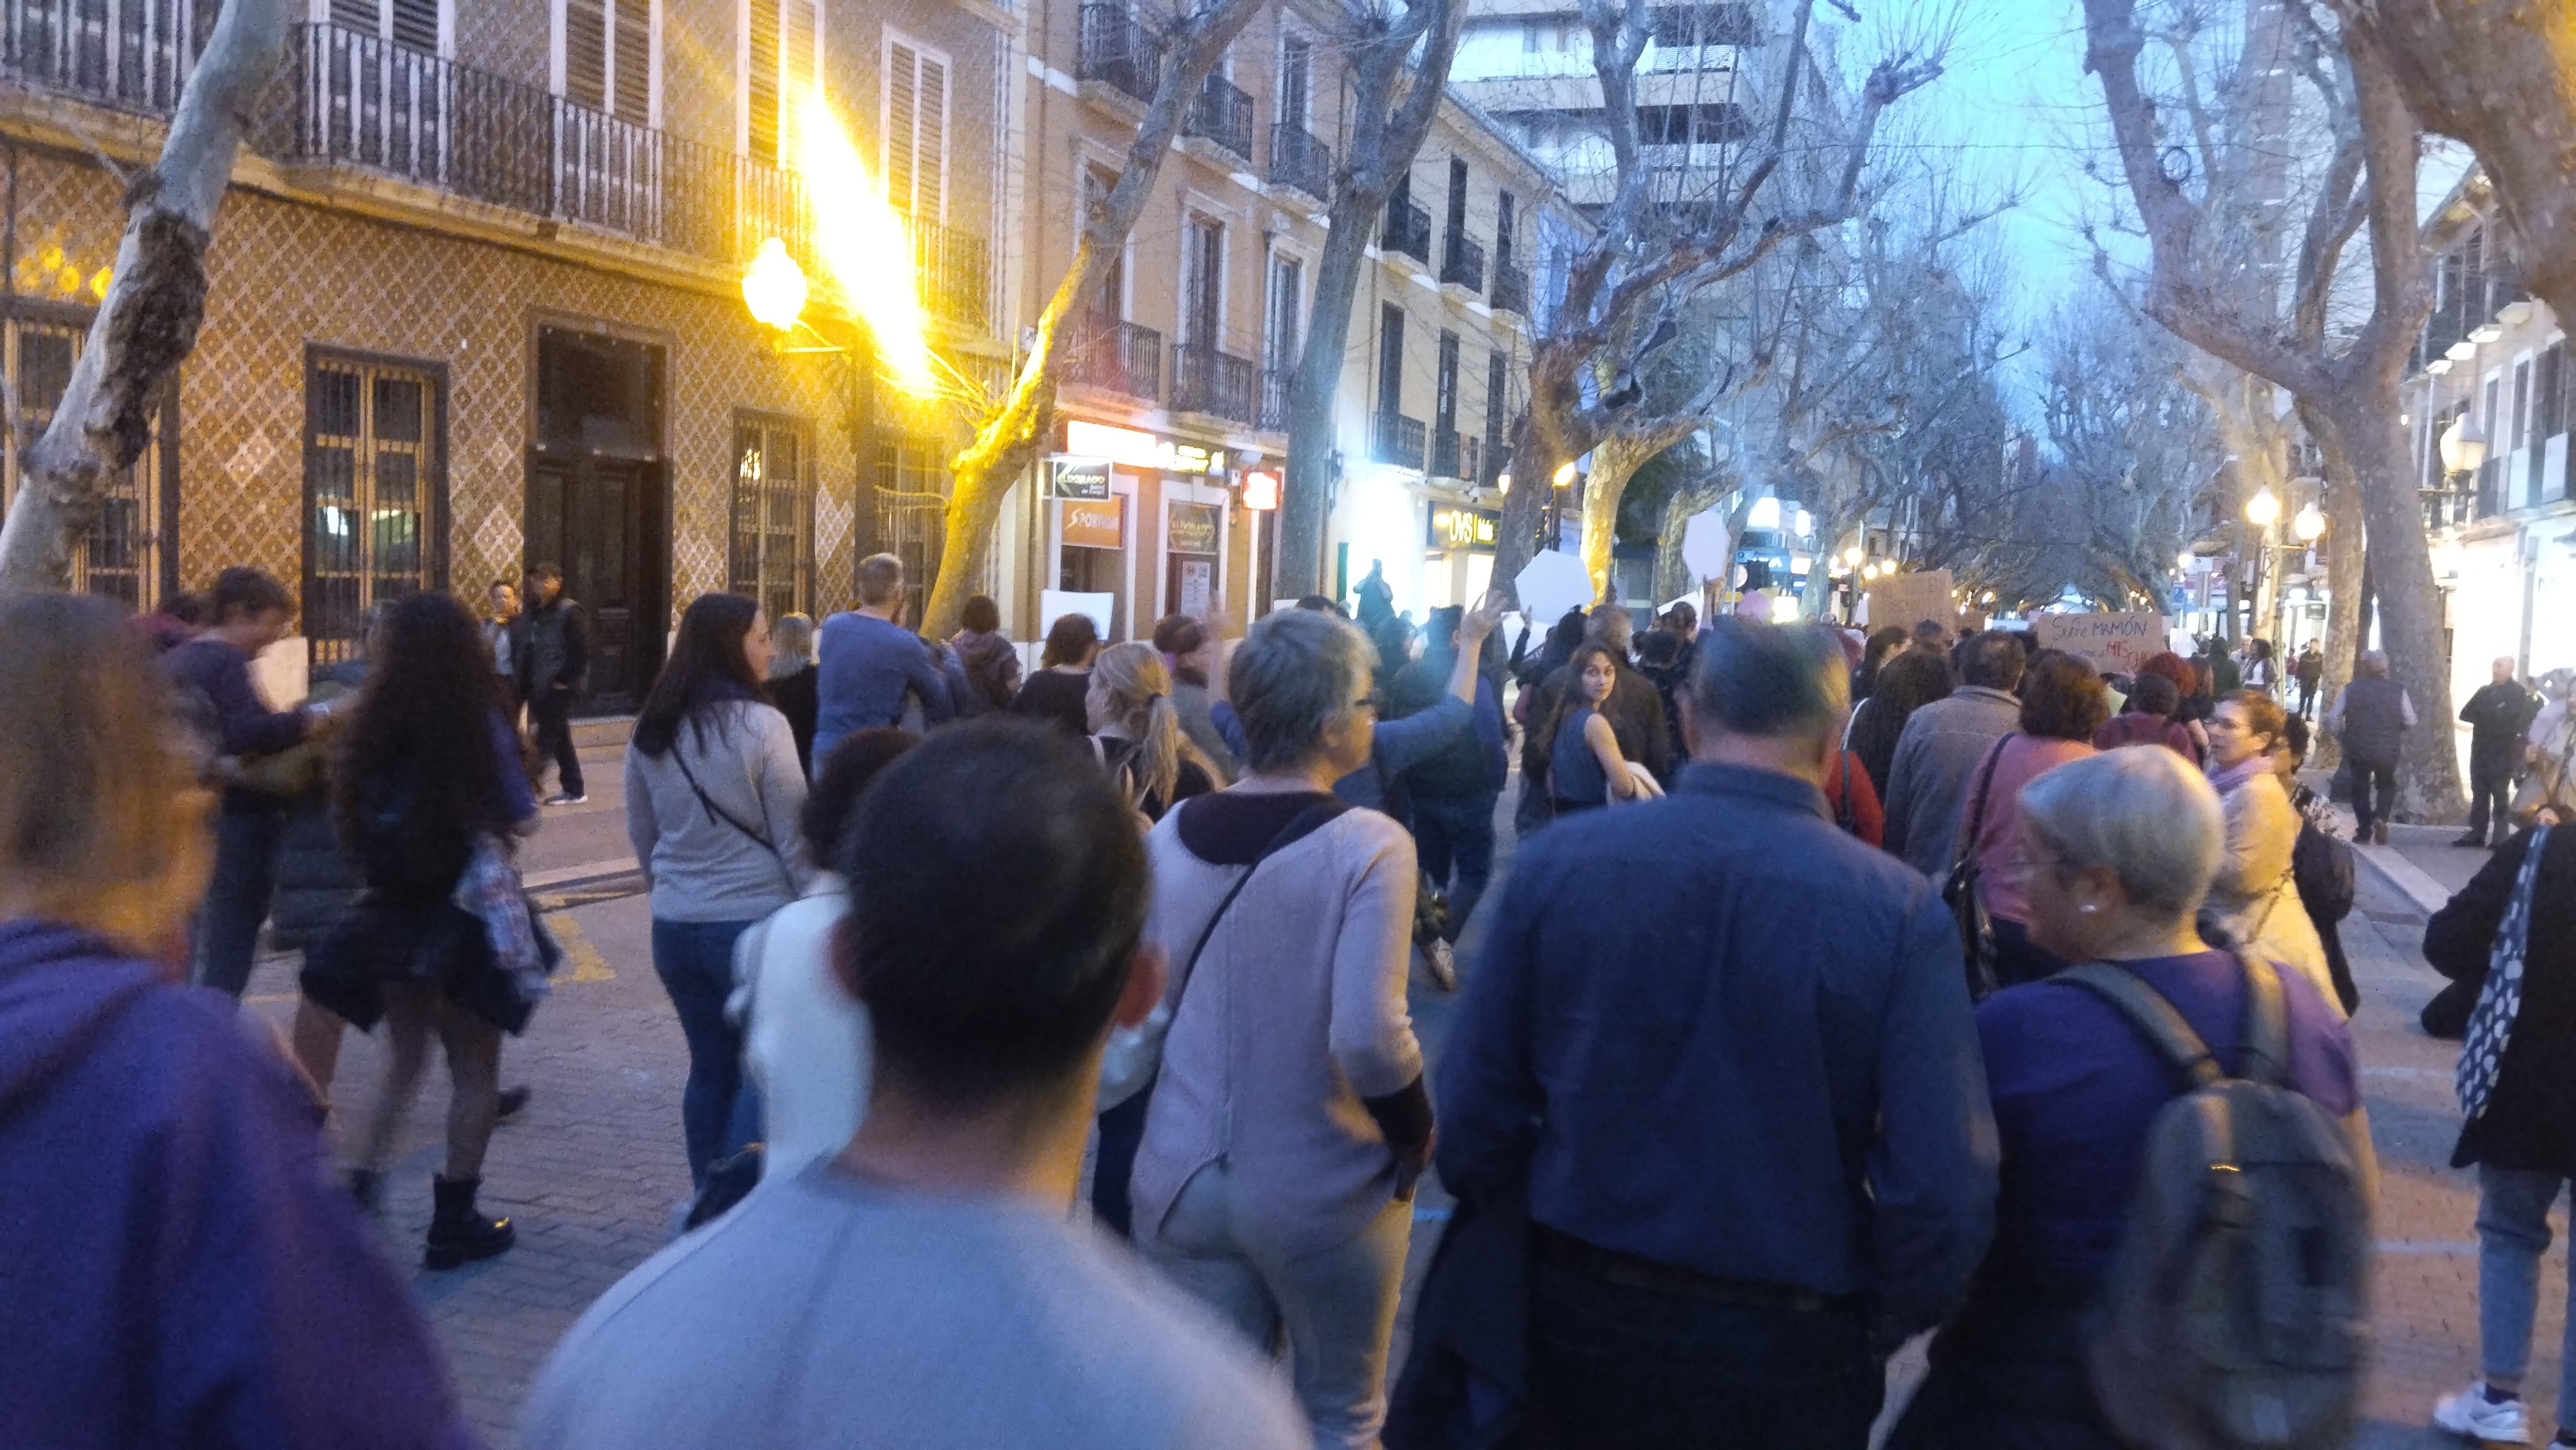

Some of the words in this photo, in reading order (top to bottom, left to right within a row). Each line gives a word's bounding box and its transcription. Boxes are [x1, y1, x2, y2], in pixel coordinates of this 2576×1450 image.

[1449, 510, 1473, 544] OVS
[2092, 615, 2148, 637] MAMÓN
[2106, 640, 2128, 658] MIS
